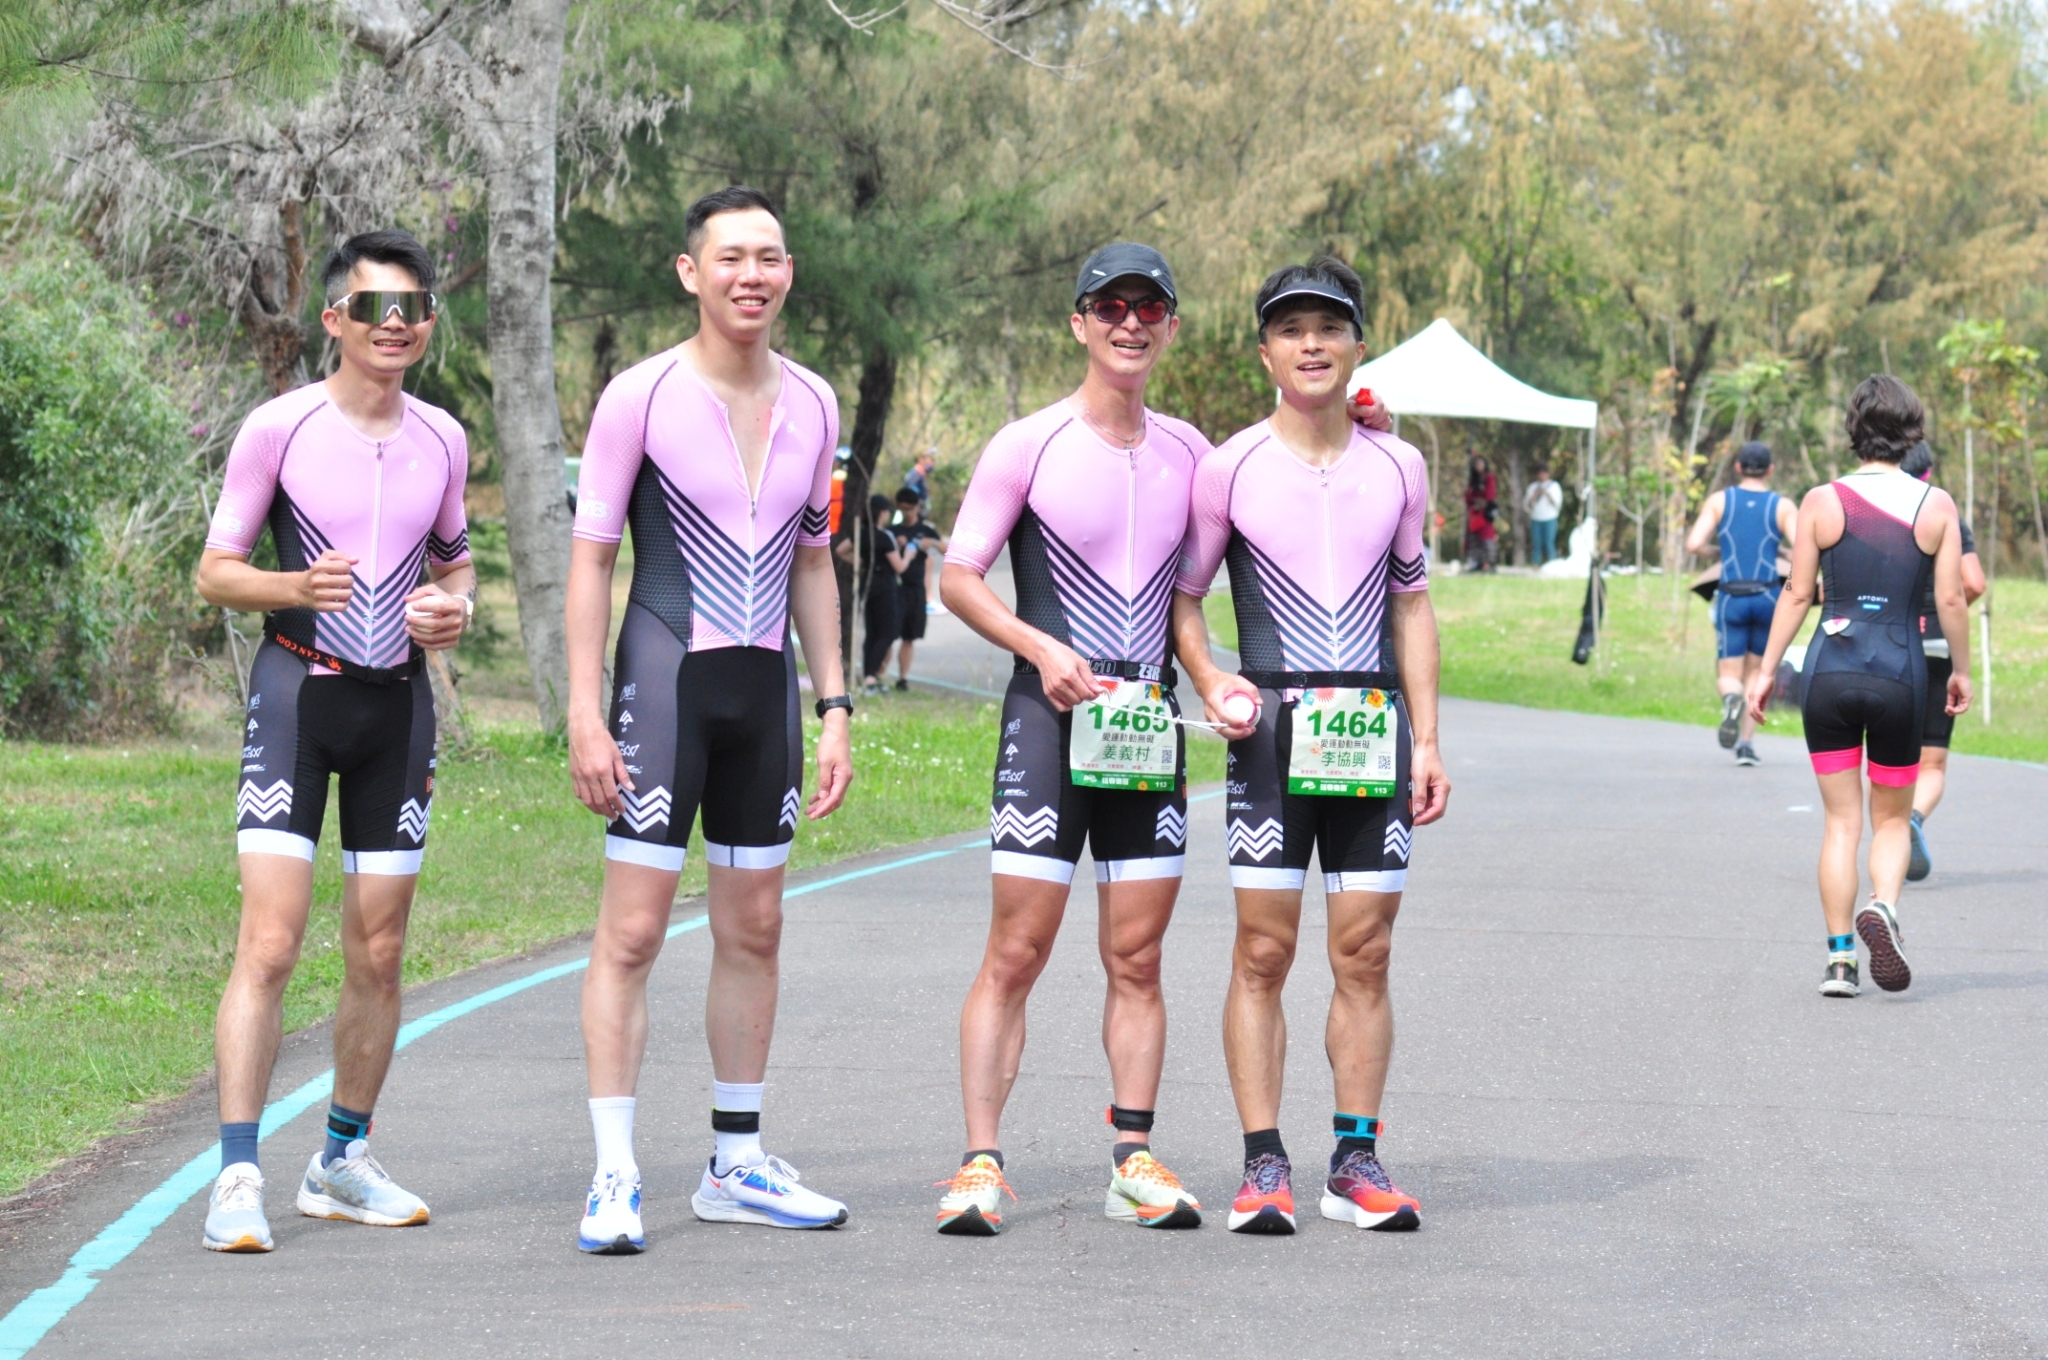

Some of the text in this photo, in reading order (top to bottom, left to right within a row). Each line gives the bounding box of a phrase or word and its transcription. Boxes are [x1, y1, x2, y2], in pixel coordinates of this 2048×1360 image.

[299, 646, 321, 661] CAN
[1088, 704, 1169, 733] 1465
[1307, 709, 1388, 738] 1464
[1102, 732, 1155, 744] 愛運動動無礙
[1320, 739, 1371, 749] 愛運動動無礙
[1102, 744, 1151, 762] 姜義村
[1321, 751, 1367, 768] 李協興
